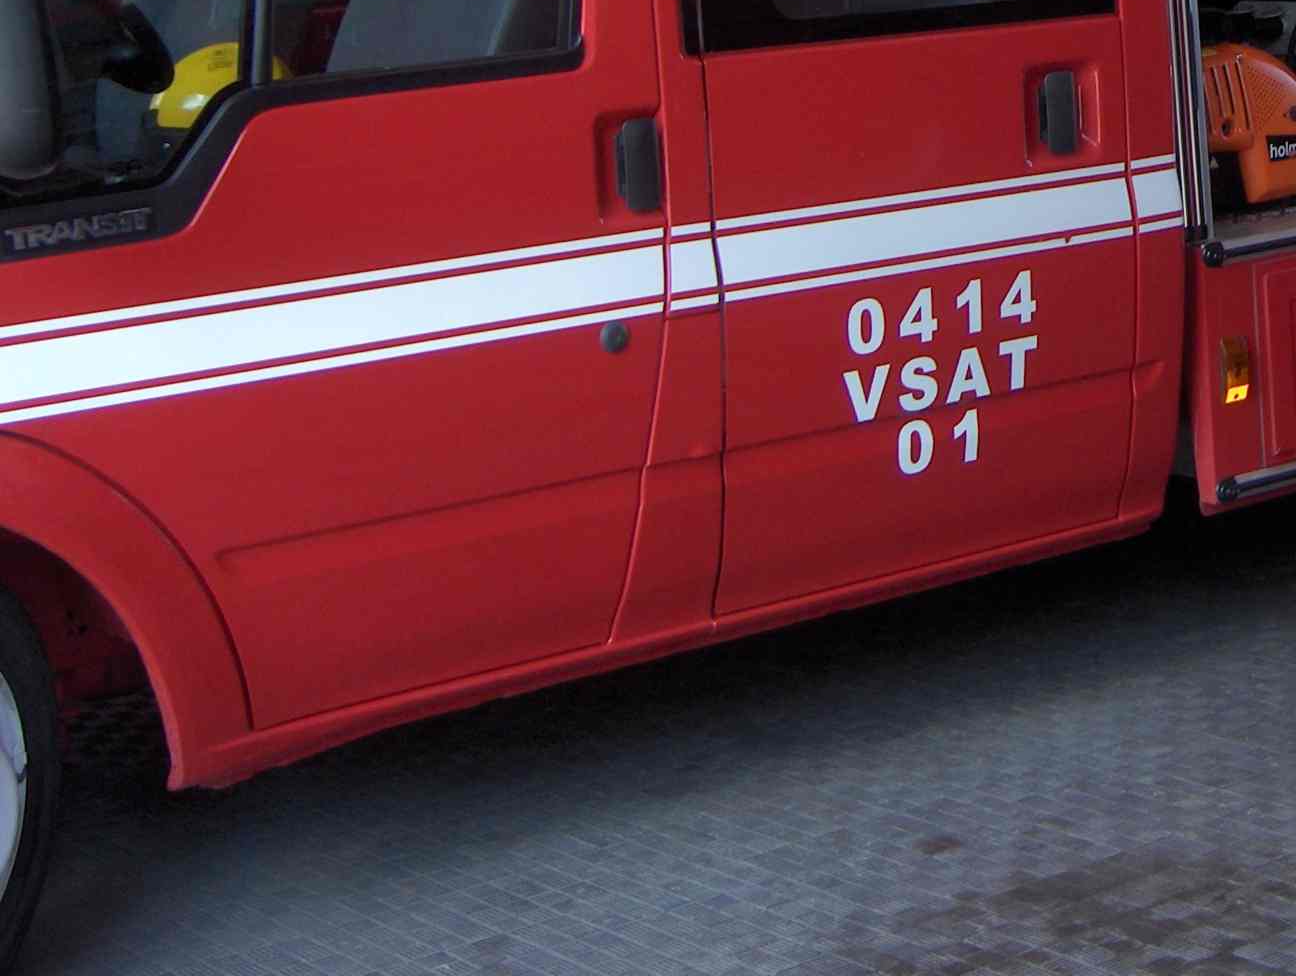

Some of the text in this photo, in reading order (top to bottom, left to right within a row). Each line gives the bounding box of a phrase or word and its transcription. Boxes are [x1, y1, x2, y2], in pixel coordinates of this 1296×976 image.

[4, 207, 151, 250] TRANSIT
[847, 270, 1037, 355] 0414
[842, 335, 1038, 423] VSAT
[897, 409, 979, 475] 01
